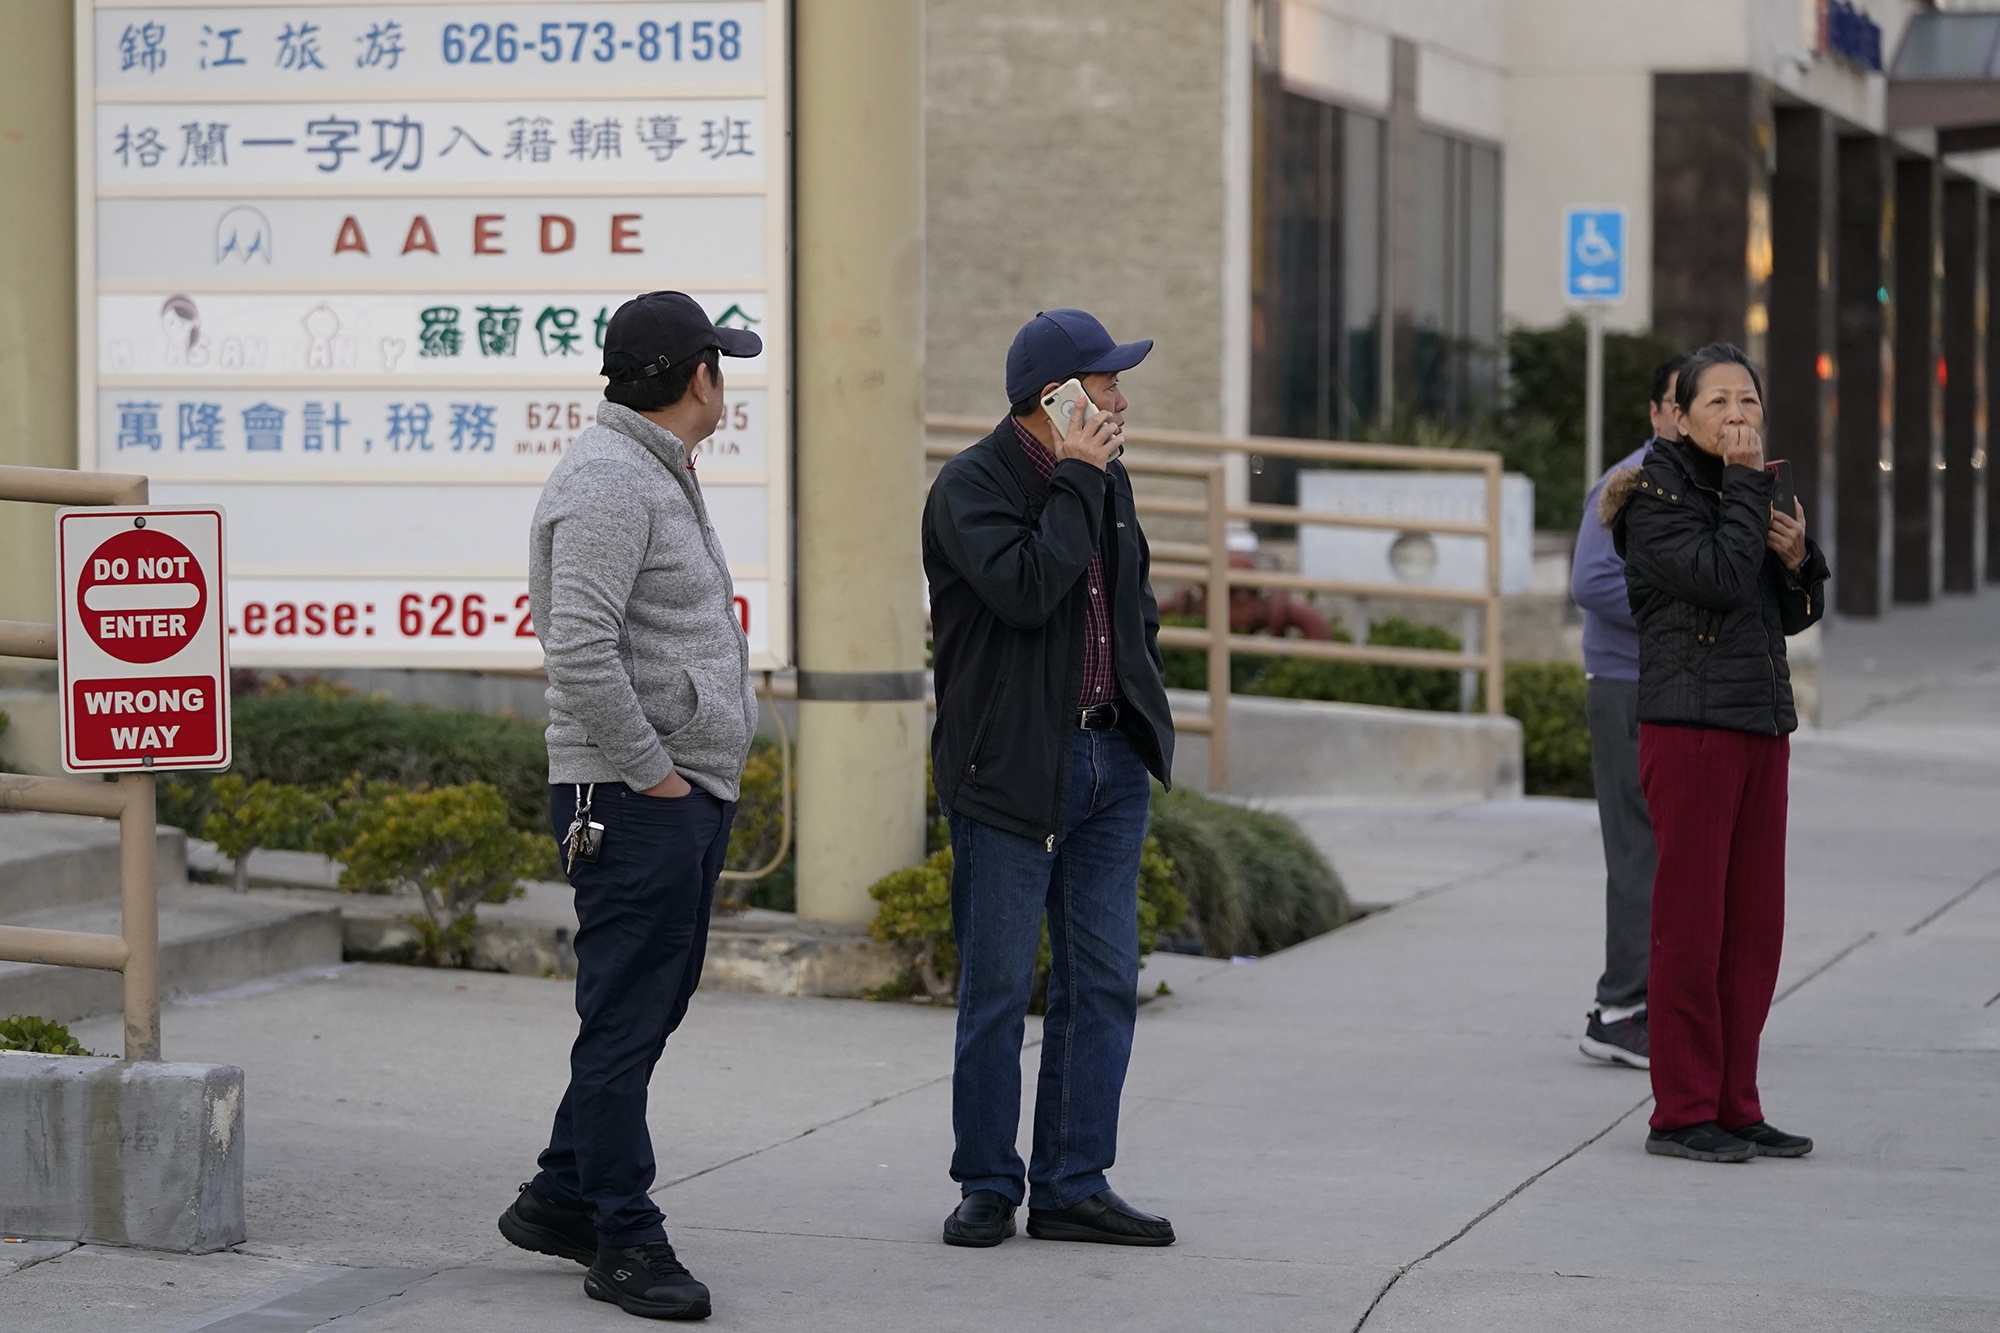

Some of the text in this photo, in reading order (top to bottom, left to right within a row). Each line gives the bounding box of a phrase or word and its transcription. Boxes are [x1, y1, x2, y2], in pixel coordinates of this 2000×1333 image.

[442, 20, 742, 64] 626-573-8158
[94, 556, 190, 580] DO NOT
[100, 614, 187, 639] ENTER
[84, 688, 204, 715] WRONG
[111, 725, 181, 750] WAY
